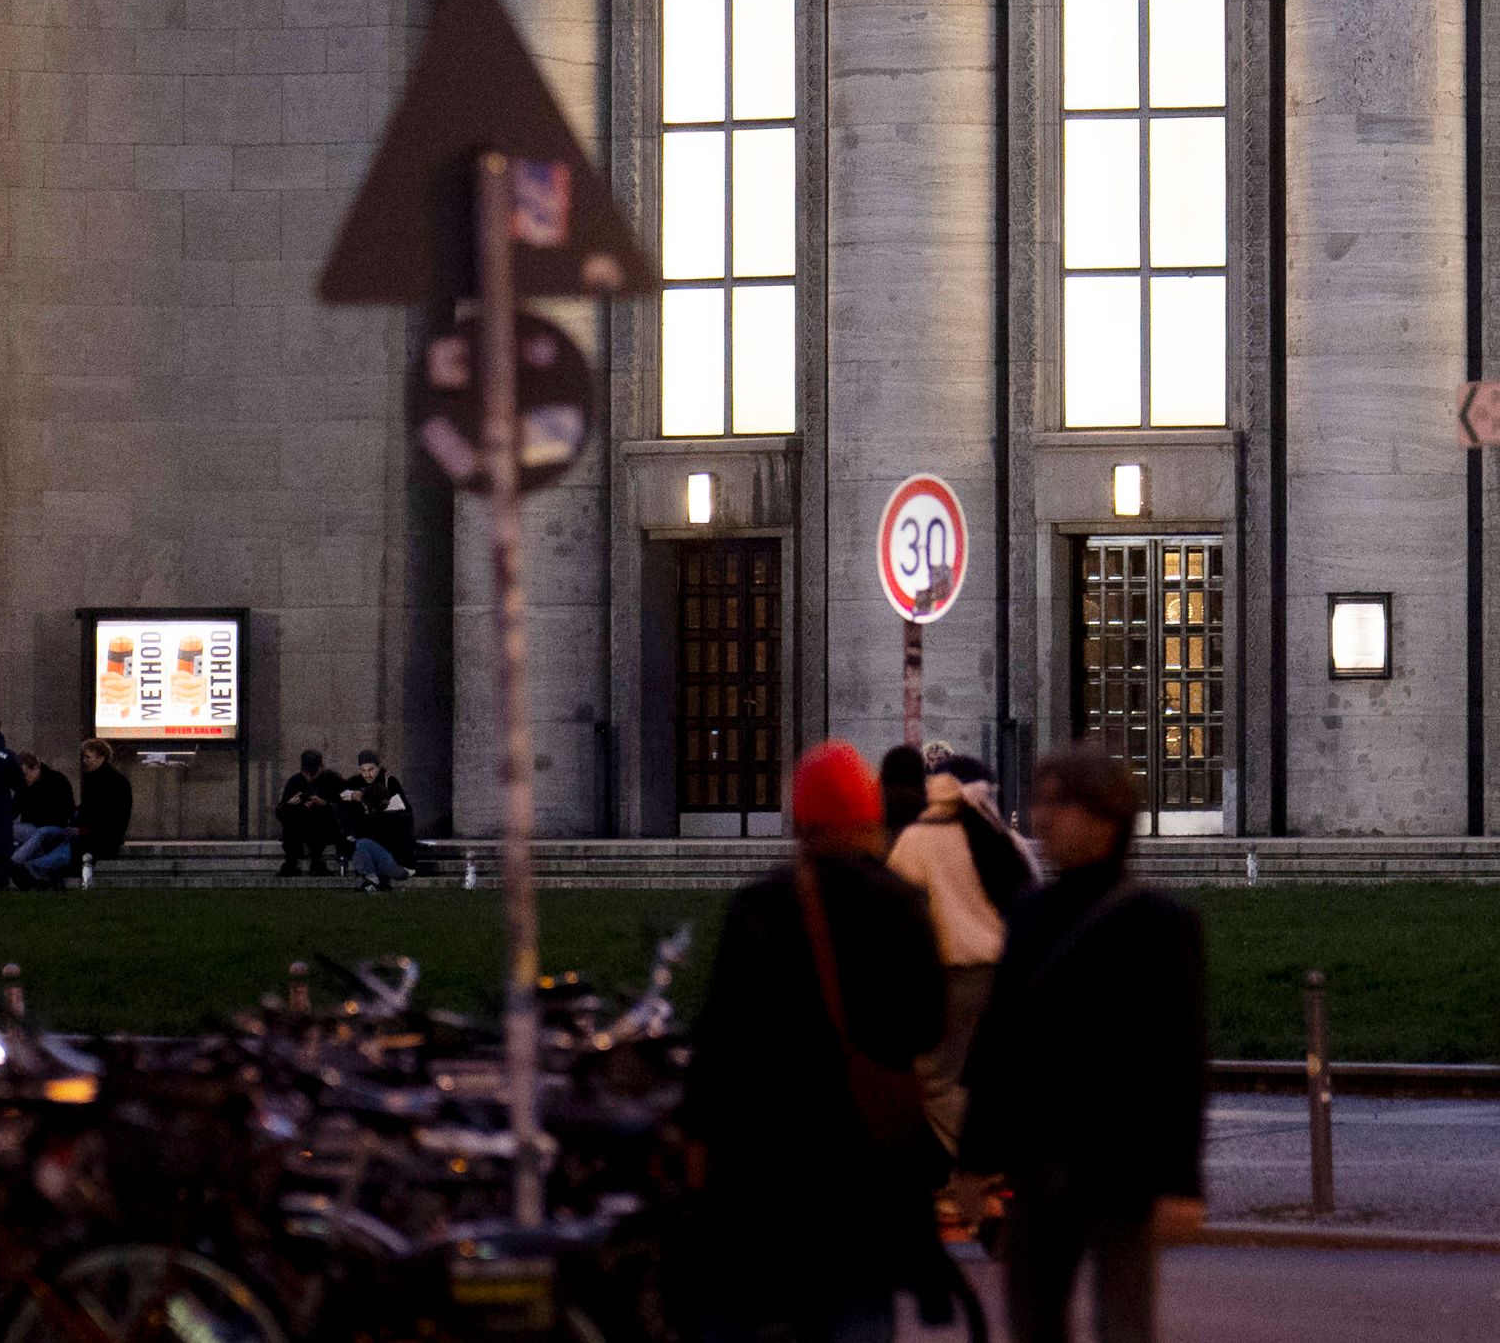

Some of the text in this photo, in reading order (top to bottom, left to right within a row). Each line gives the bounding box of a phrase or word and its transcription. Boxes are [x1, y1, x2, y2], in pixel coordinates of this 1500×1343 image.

[900, 517, 947, 578] 30
[140, 631, 162, 721] METHOD
[210, 630, 232, 720] METHOD
[193, 726, 222, 735] SALON
